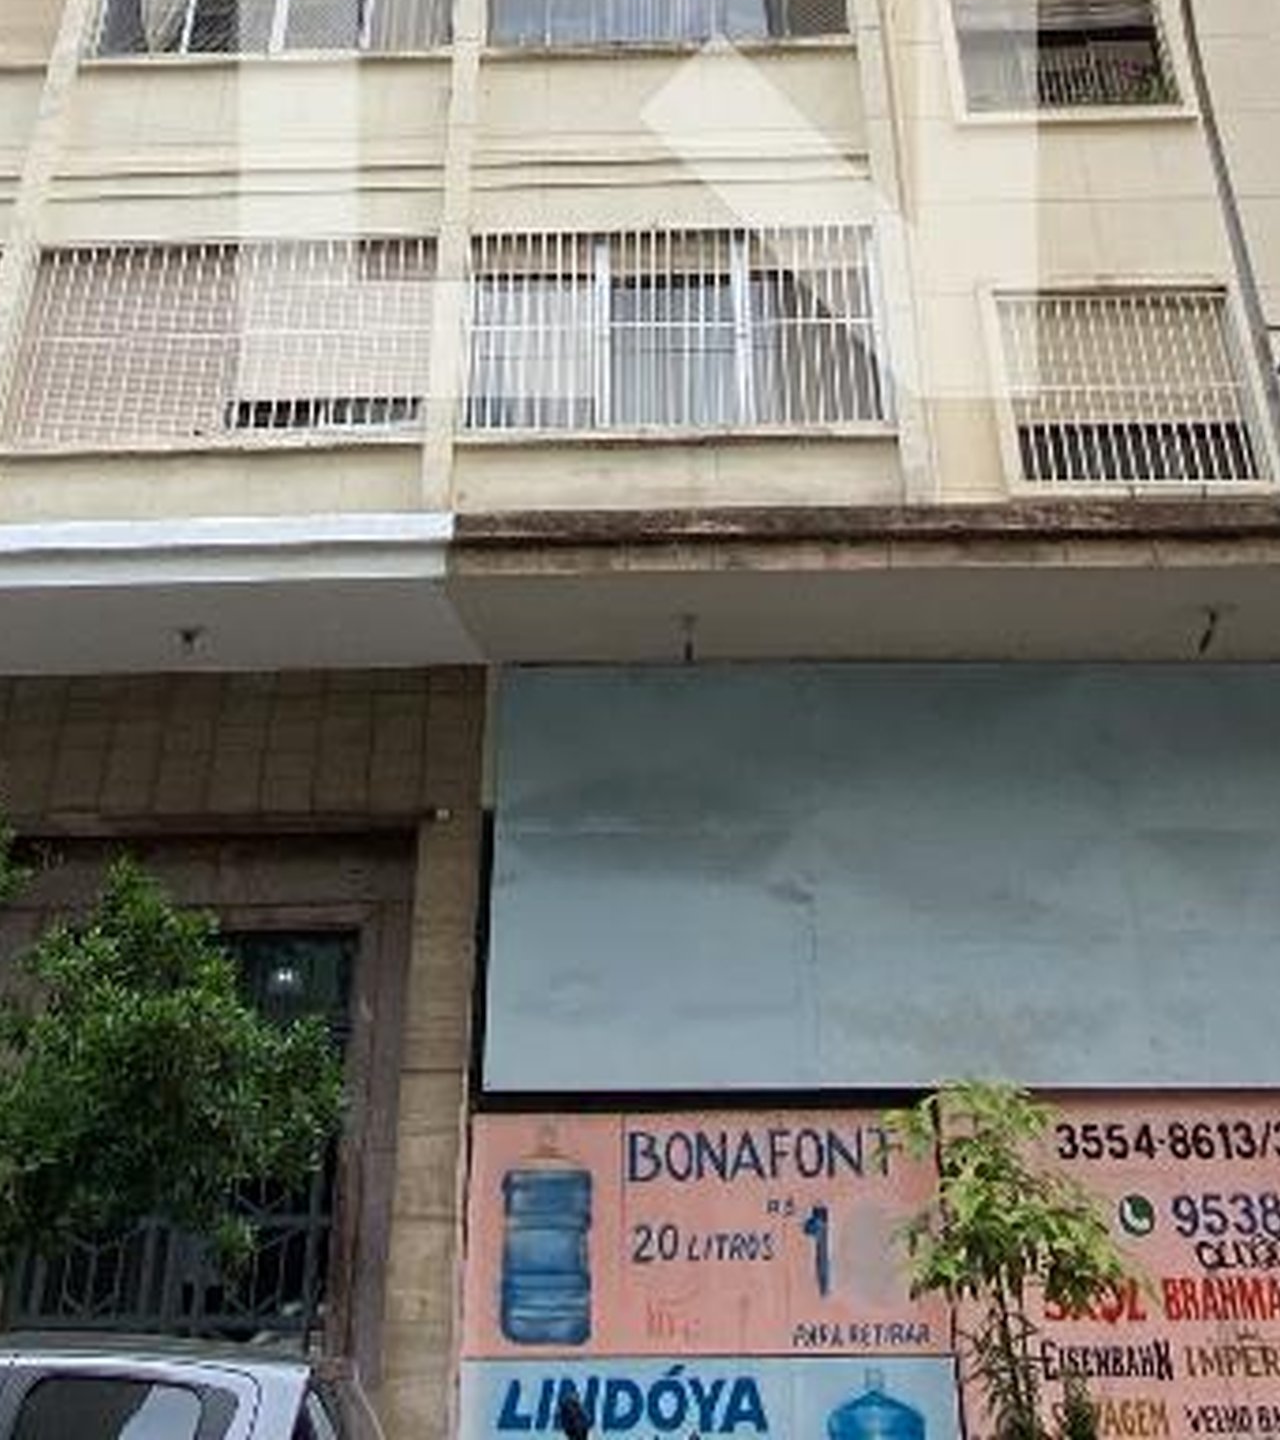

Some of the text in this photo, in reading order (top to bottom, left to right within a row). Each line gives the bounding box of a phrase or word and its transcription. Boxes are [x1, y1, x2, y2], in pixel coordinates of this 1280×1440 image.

[628, 1126, 897, 1183] BONAFONT
[632, 1224, 775, 1262] 20 LITROS
[792, 1323, 844, 1348] PARA
[1040, 1339, 1174, 1382] EISENBAHN
[496, 1363, 769, 1433] LINDÓYA
